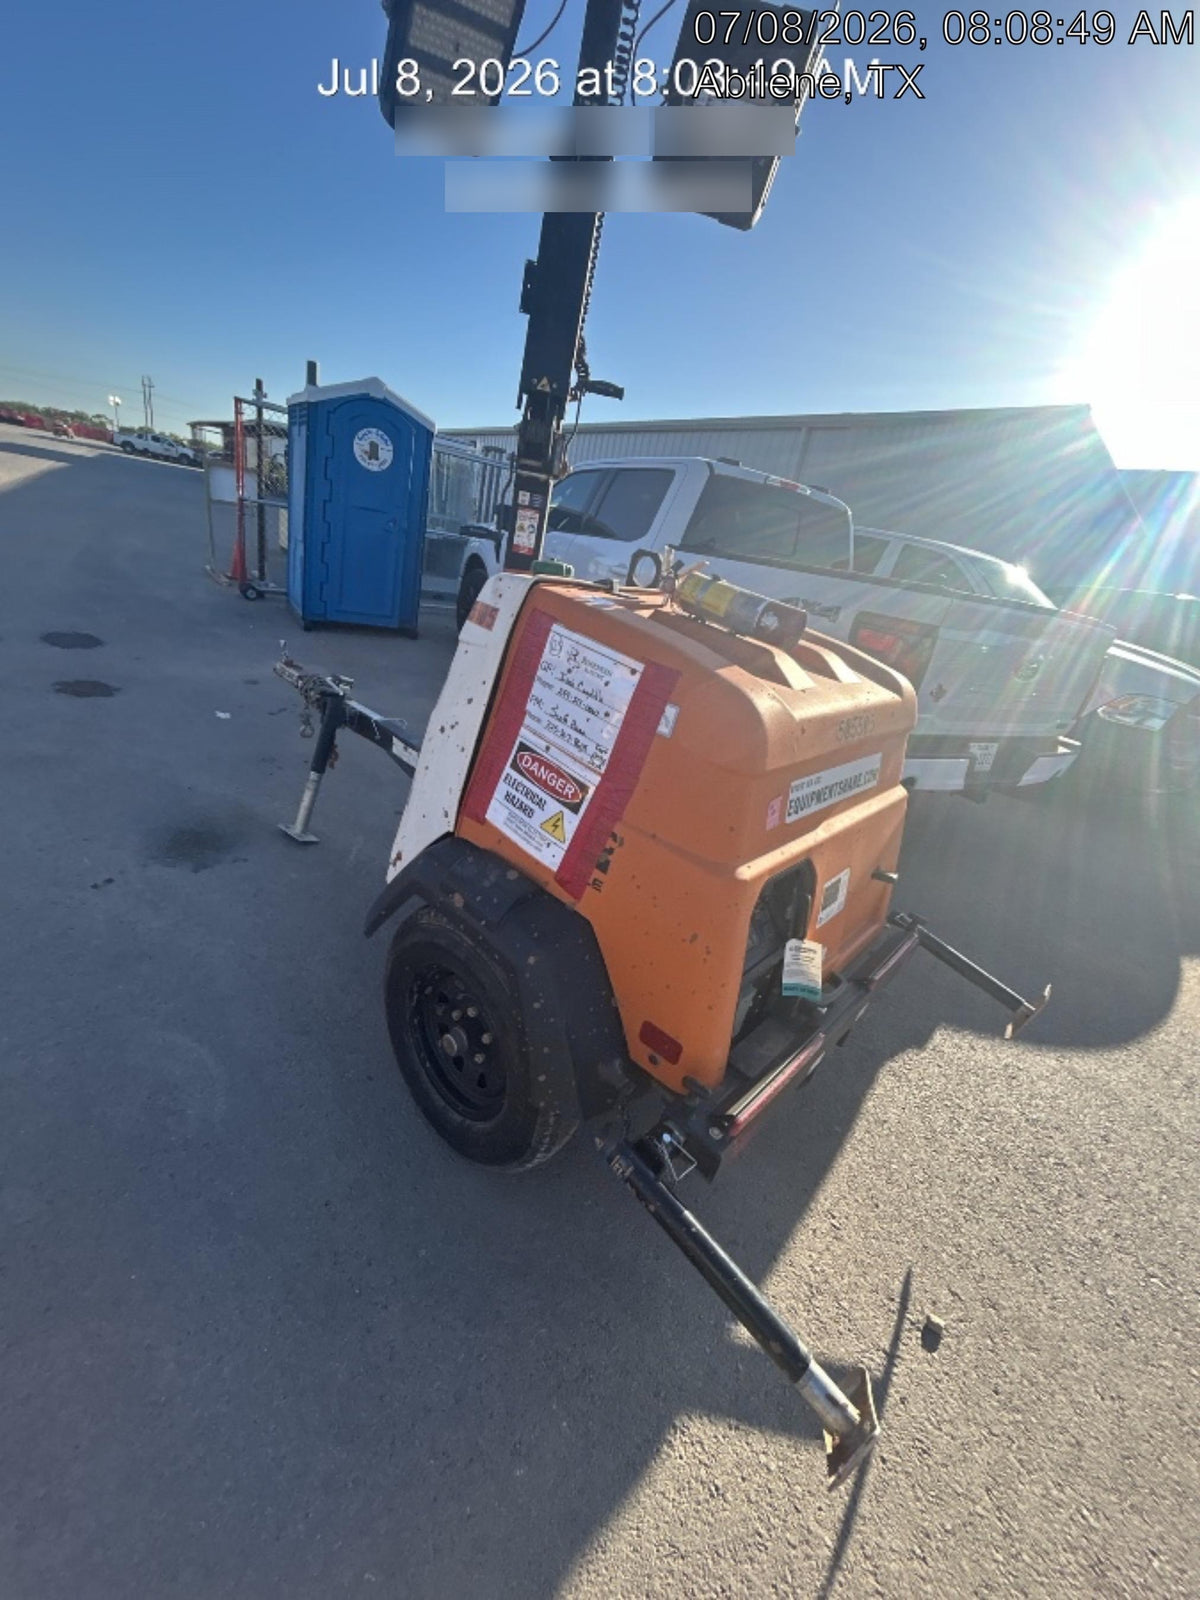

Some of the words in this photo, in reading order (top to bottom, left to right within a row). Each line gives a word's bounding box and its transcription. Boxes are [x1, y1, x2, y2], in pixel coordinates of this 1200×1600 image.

[503, 772, 547, 812] ELECTRICAL
[521, 754, 576, 799] DANGER
[504, 790, 535, 819] HAZARD
